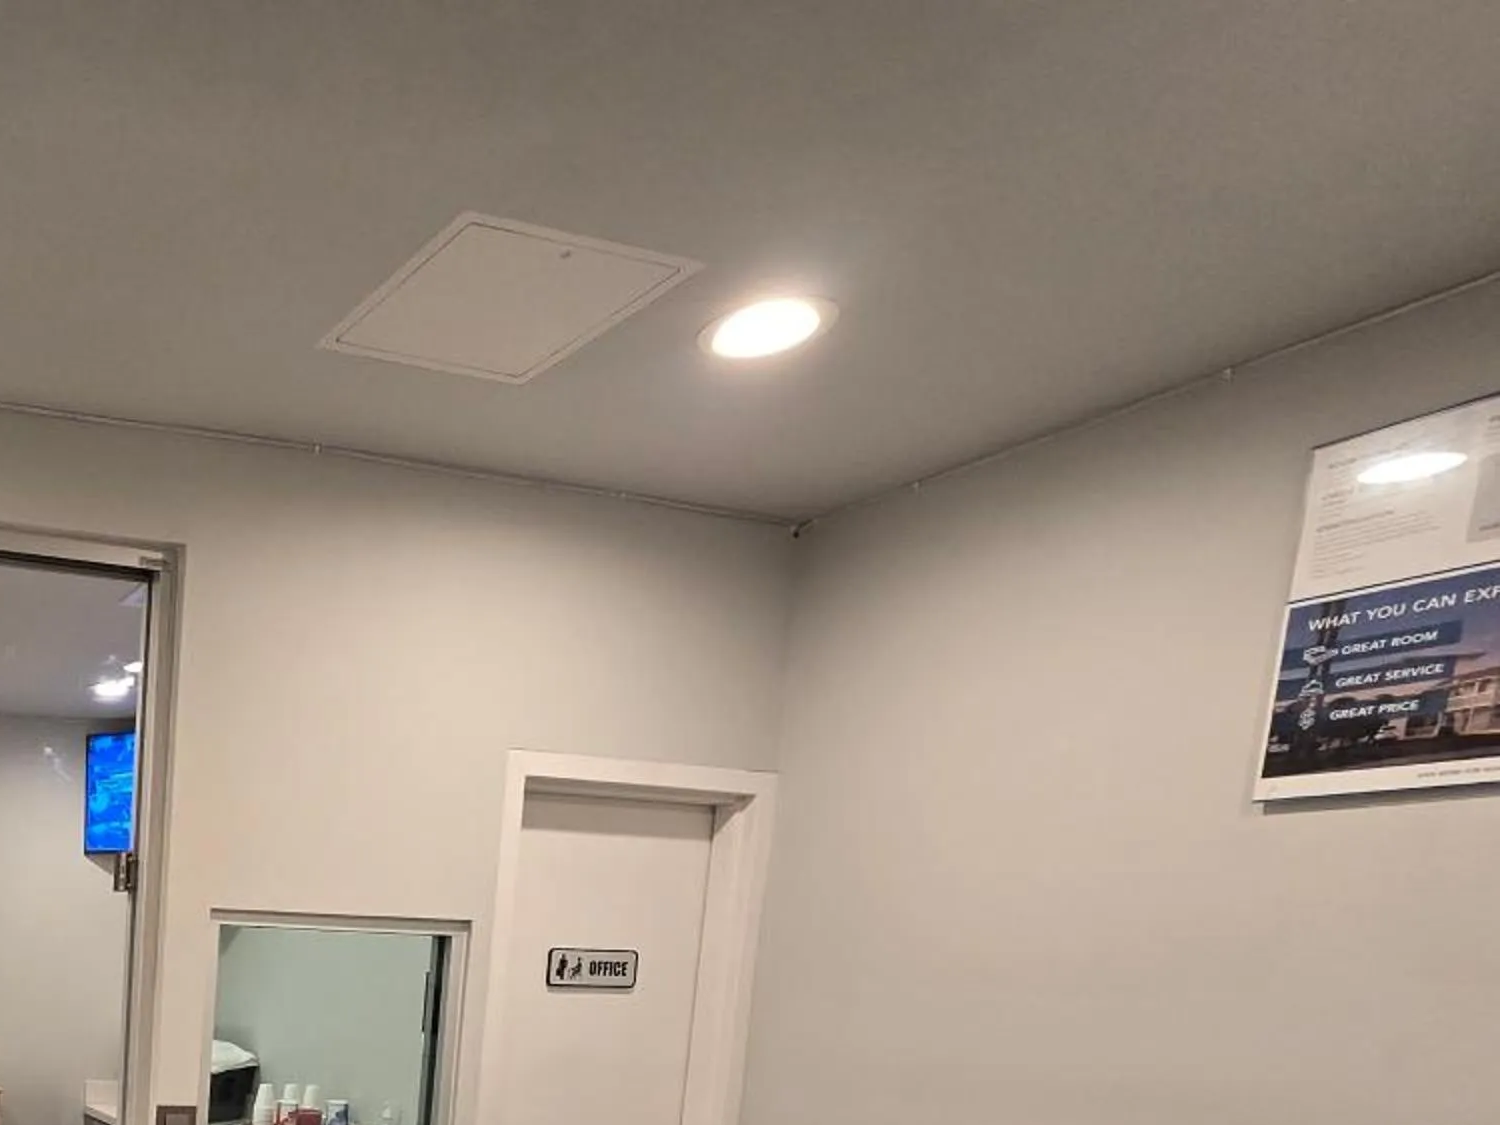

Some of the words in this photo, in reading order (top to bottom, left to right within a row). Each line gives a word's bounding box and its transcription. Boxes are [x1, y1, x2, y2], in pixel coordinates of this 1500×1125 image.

[1308, 611, 1361, 632] WHAT
[1366, 603, 1406, 620] YOU
[1413, 593, 1457, 613] CAN
[1341, 639, 1387, 656] GREAT
[1391, 630, 1439, 647] ROOM
[1335, 673, 1380, 688] GREAT
[1385, 663, 1445, 680] SERVICE
[1329, 705, 1375, 721] GREAT
[1378, 700, 1420, 714] PRICE
[589, 961, 629, 976] OFFICE
